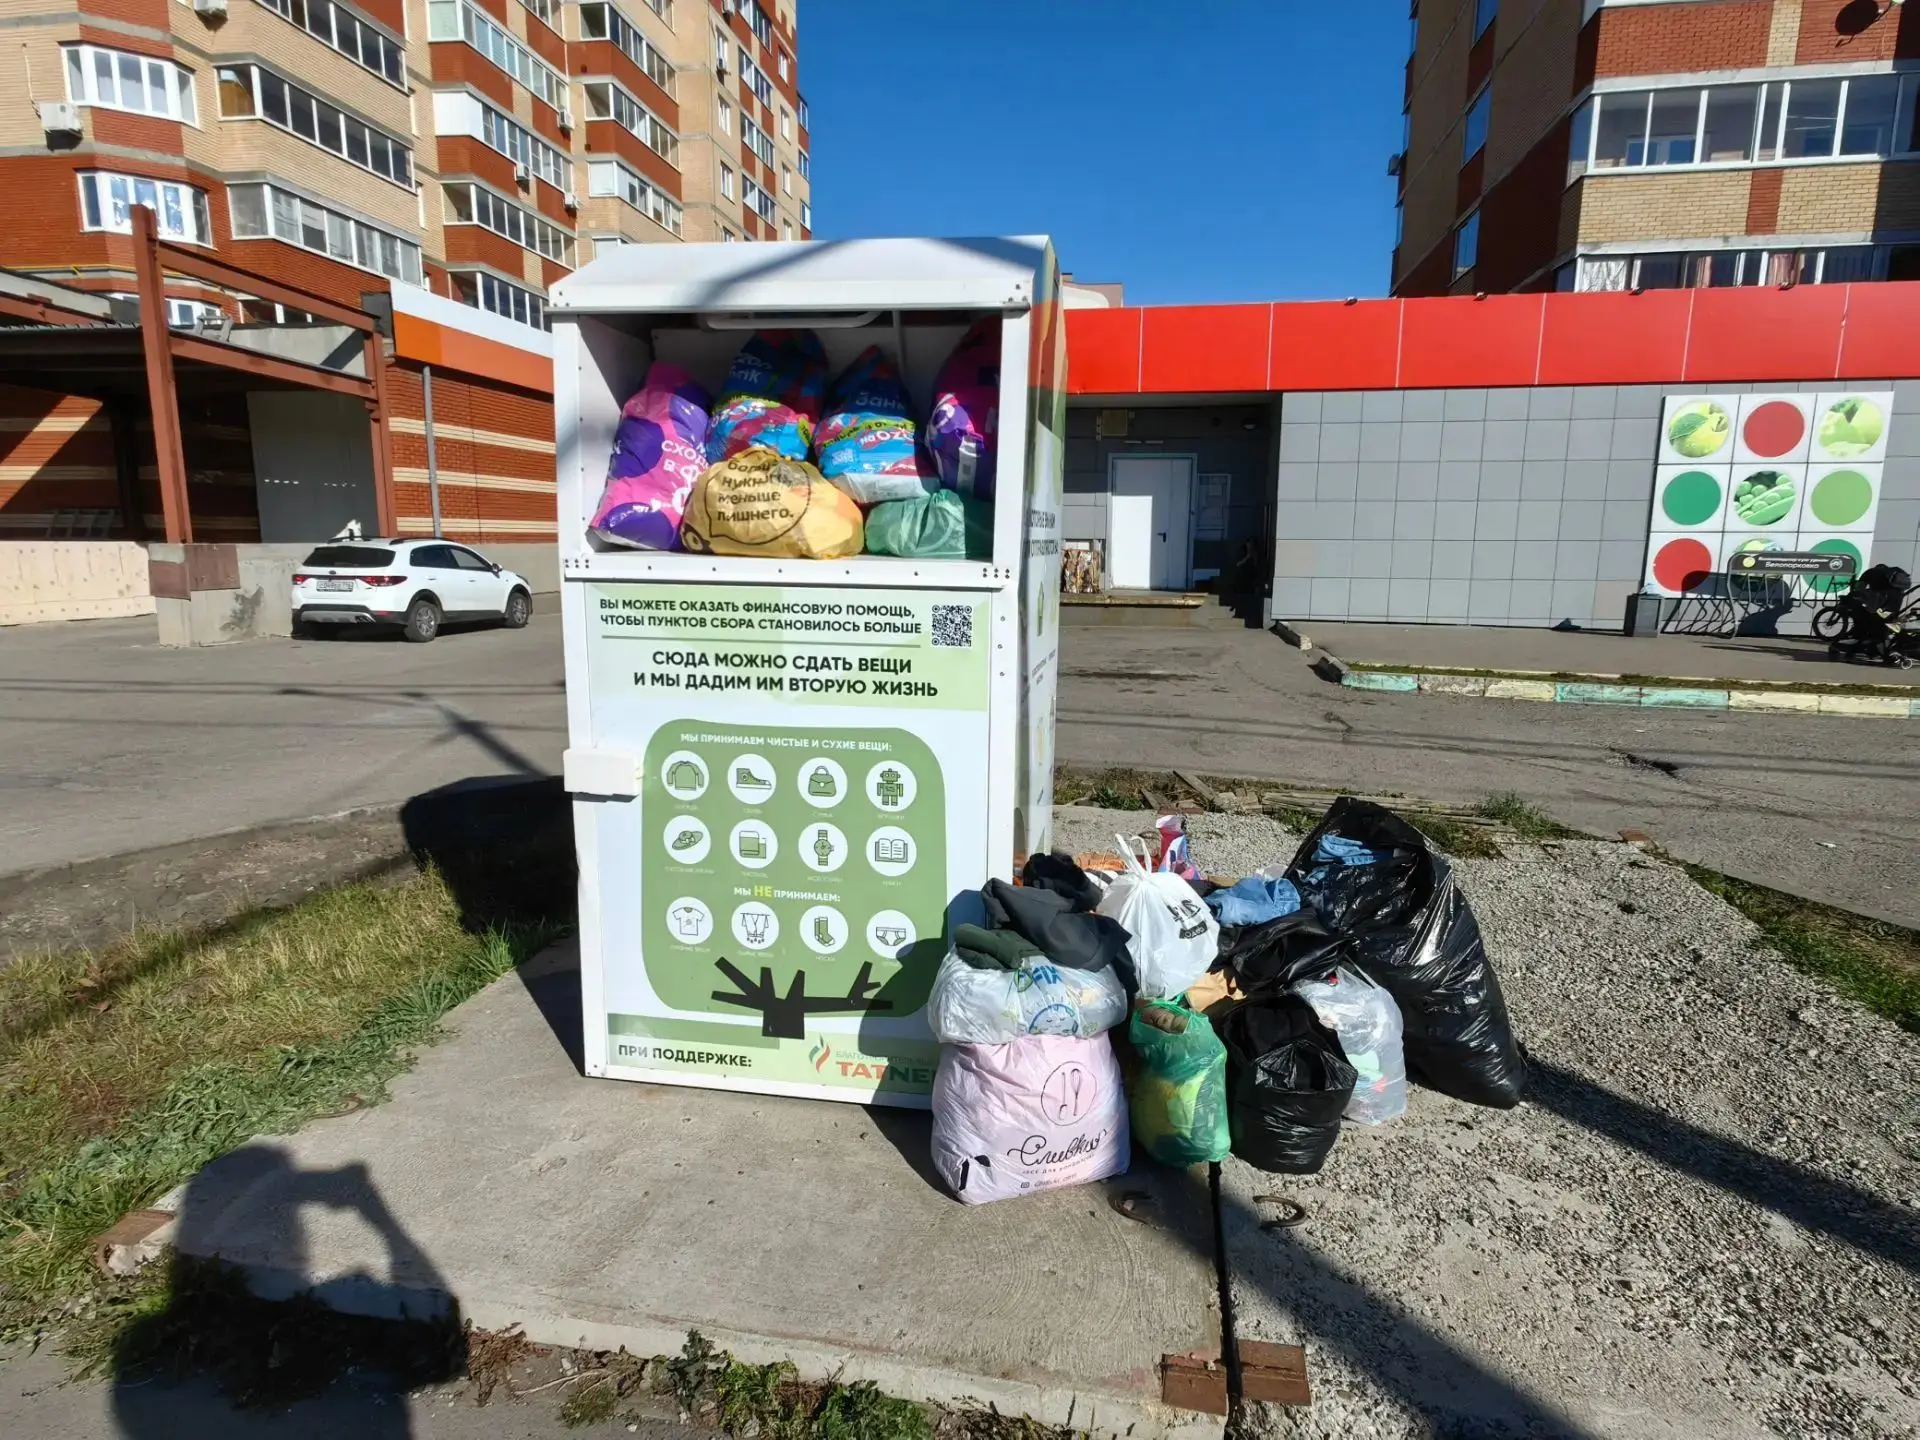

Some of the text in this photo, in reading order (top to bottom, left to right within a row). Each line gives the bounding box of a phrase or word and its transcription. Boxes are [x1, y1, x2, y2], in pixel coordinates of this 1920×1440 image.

[599, 598, 915, 618] ВЫ МОЖЕТЕ ОКАЗАТЬ ФИНАНСОВУЮ ПОМОЩЬ,
[600, 615, 921, 634] ЧТОБЫ ПУНКТОВ СБОРА СТАНОВИЛОСЬ БОЛЬШЕ
[652, 651, 912, 675] СЮДА МОЖНО СДАТЬ ВЕЩИ
[634, 672, 938, 697] И МЫ ДАДИМ ИМ ВТОРУЮ ЖИЗНЬ
[680, 733, 893, 752] МЫ ПРИНИМАЕМ ЧИСТЫЕ И СУХИЕ ВЕЩИ:
[734, 885, 841, 902] МЫ НЕ ПРИНИМАЕМ:
[618, 1045, 752, 1068] ПРИ ПОДДЕРЖКЕ:
[835, 1061, 936, 1083] TATNE
